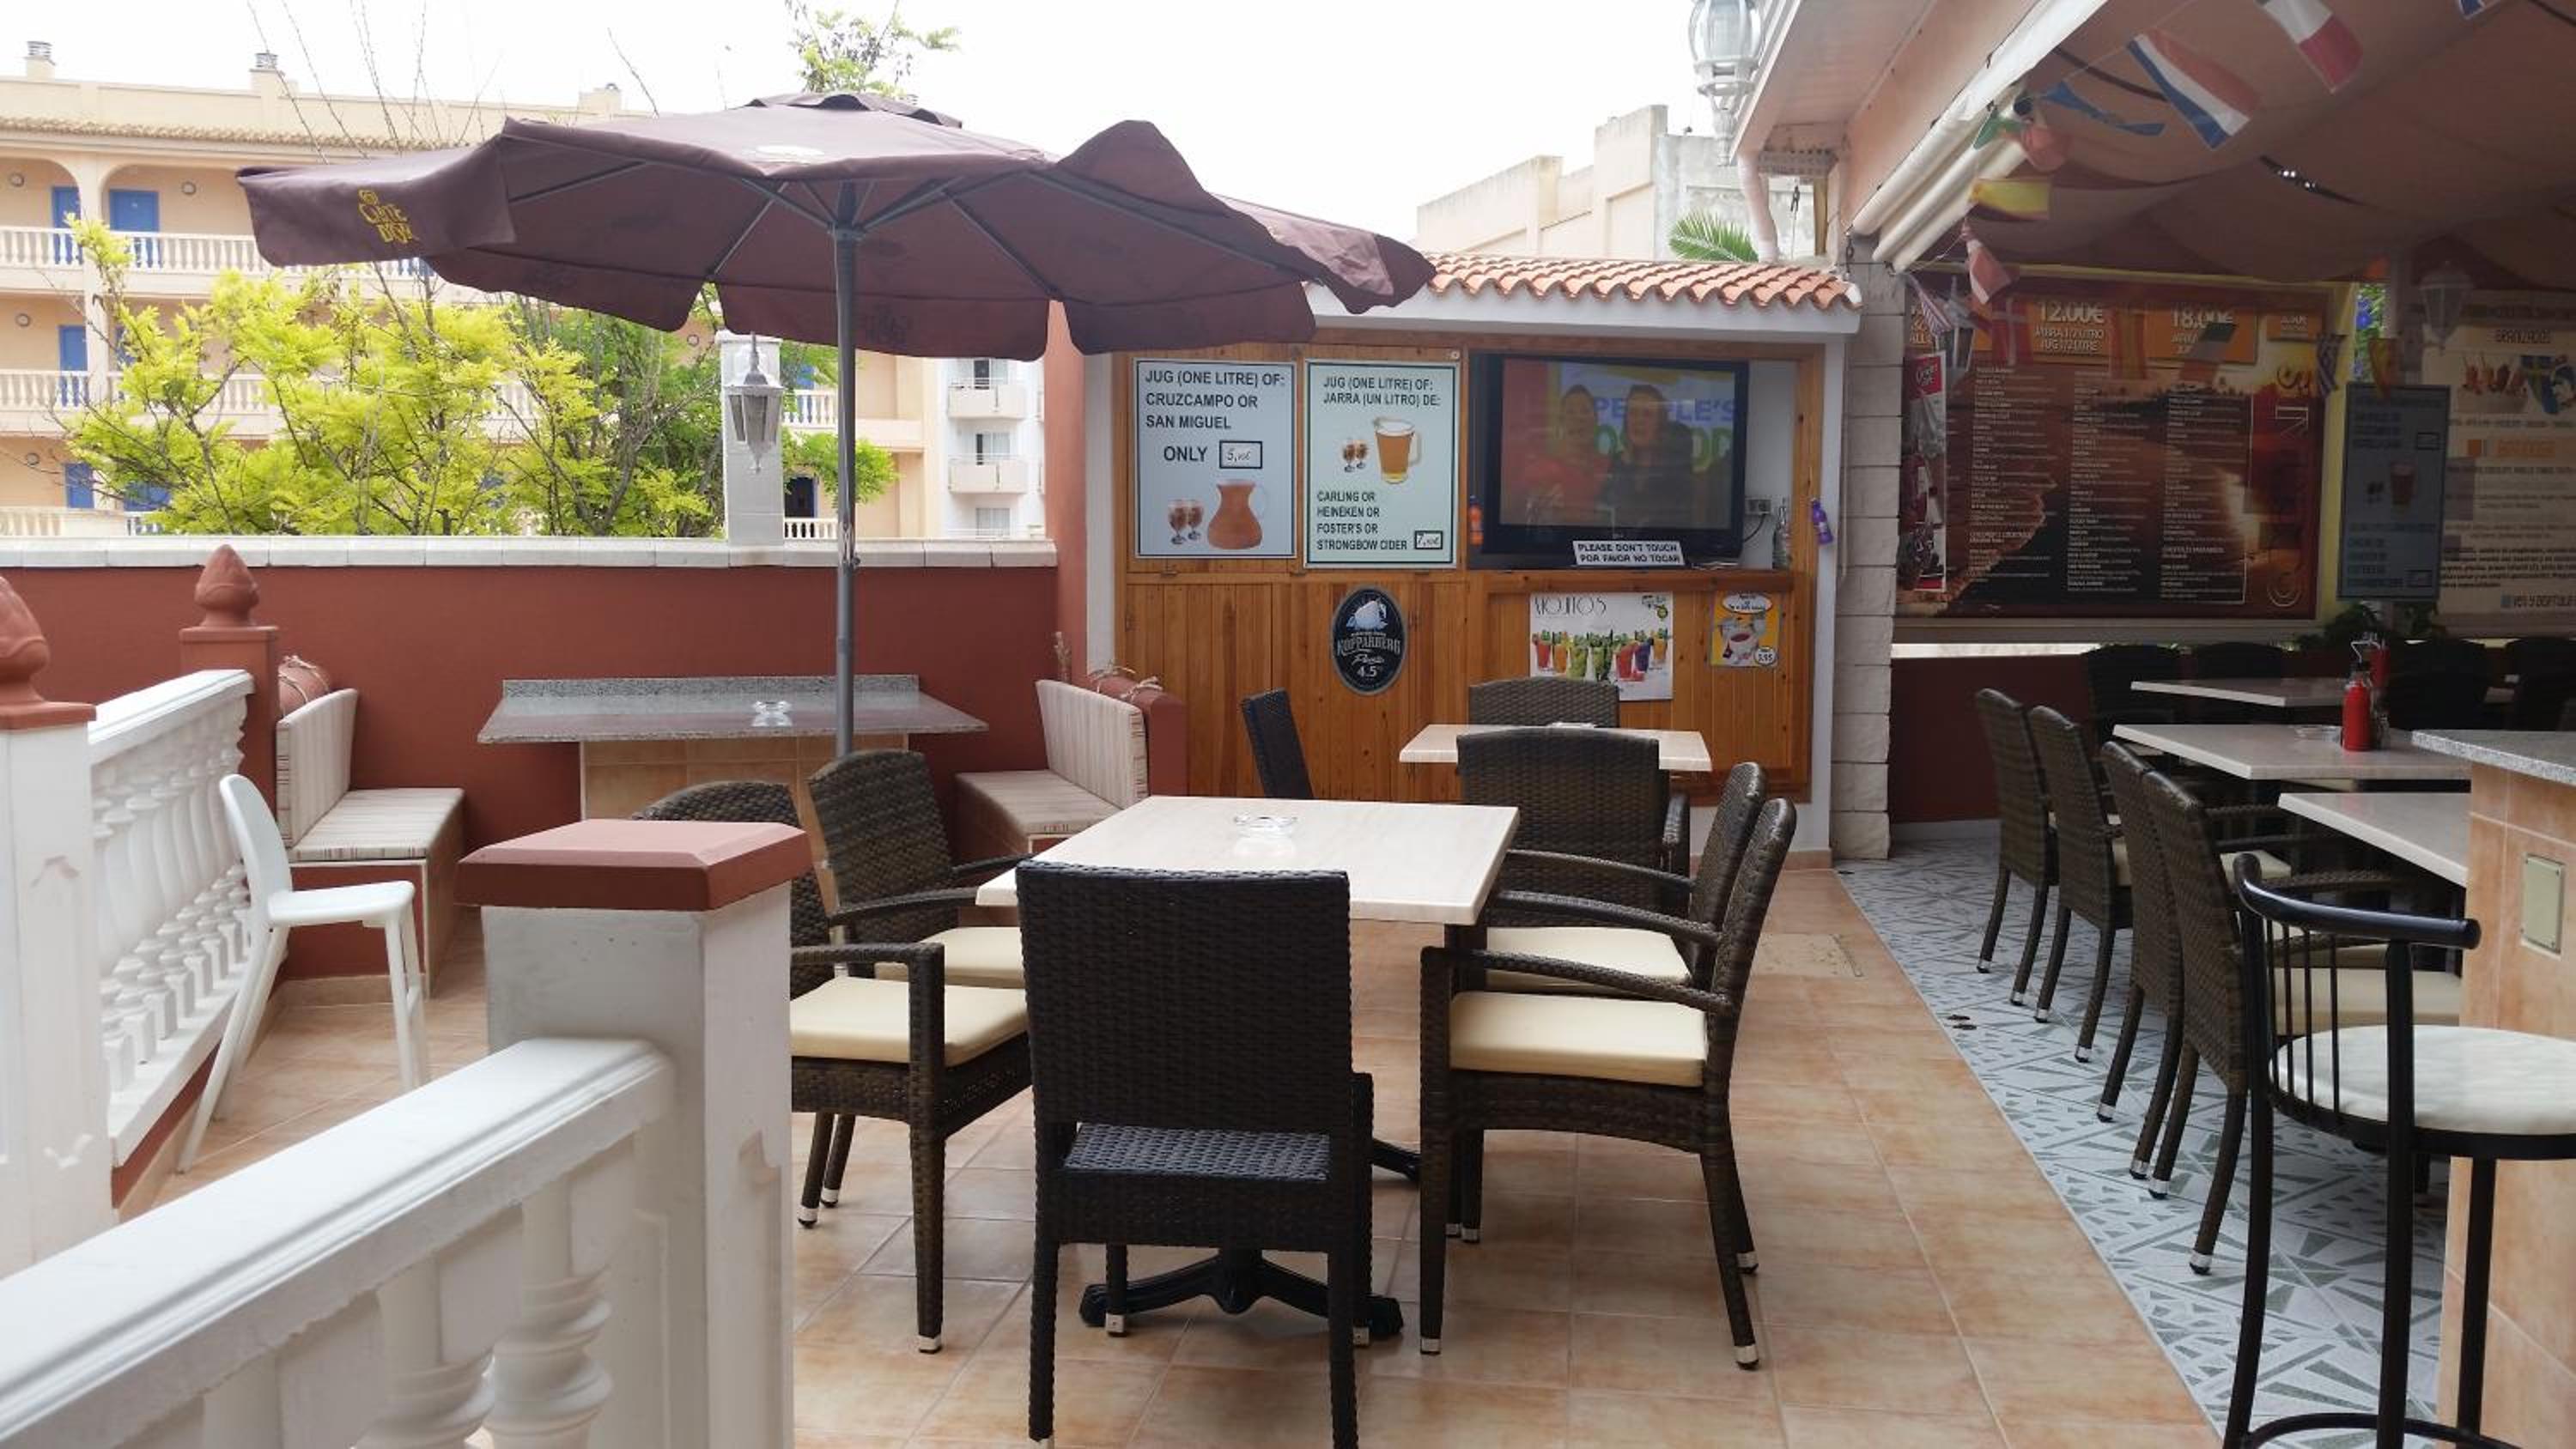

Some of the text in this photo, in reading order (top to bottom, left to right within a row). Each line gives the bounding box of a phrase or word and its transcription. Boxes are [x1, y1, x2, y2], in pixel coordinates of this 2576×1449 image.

[1145, 369, 1285, 388] JUG (ONE LITRE) OF:
[1323, 377, 1433, 391] JUG (ONE LITRE) OF:
[1145, 392, 1258, 408] CRUZCAMPO OR
[1323, 392, 1441, 408] JARRA (UN LITRO) DE:
[1145, 415, 1231, 429] SAN MIGUEL
[1163, 446, 1207, 462] ONLY
[1317, 491, 1376, 502] CARLING OR
[1317, 506, 1380, 518] HEINEKEN OR
[1317, 523, 1378, 534] FOSTER'S OR
[1316, 539, 1407, 550] STRONGBOW CIDER
[1577, 543, 1677, 552] PLEASE DON'T TOUCH
[1580, 555, 1600, 563] POR
[1602, 555, 1631, 563] FAVOR
[1650, 555, 1680, 564] TOCAR
